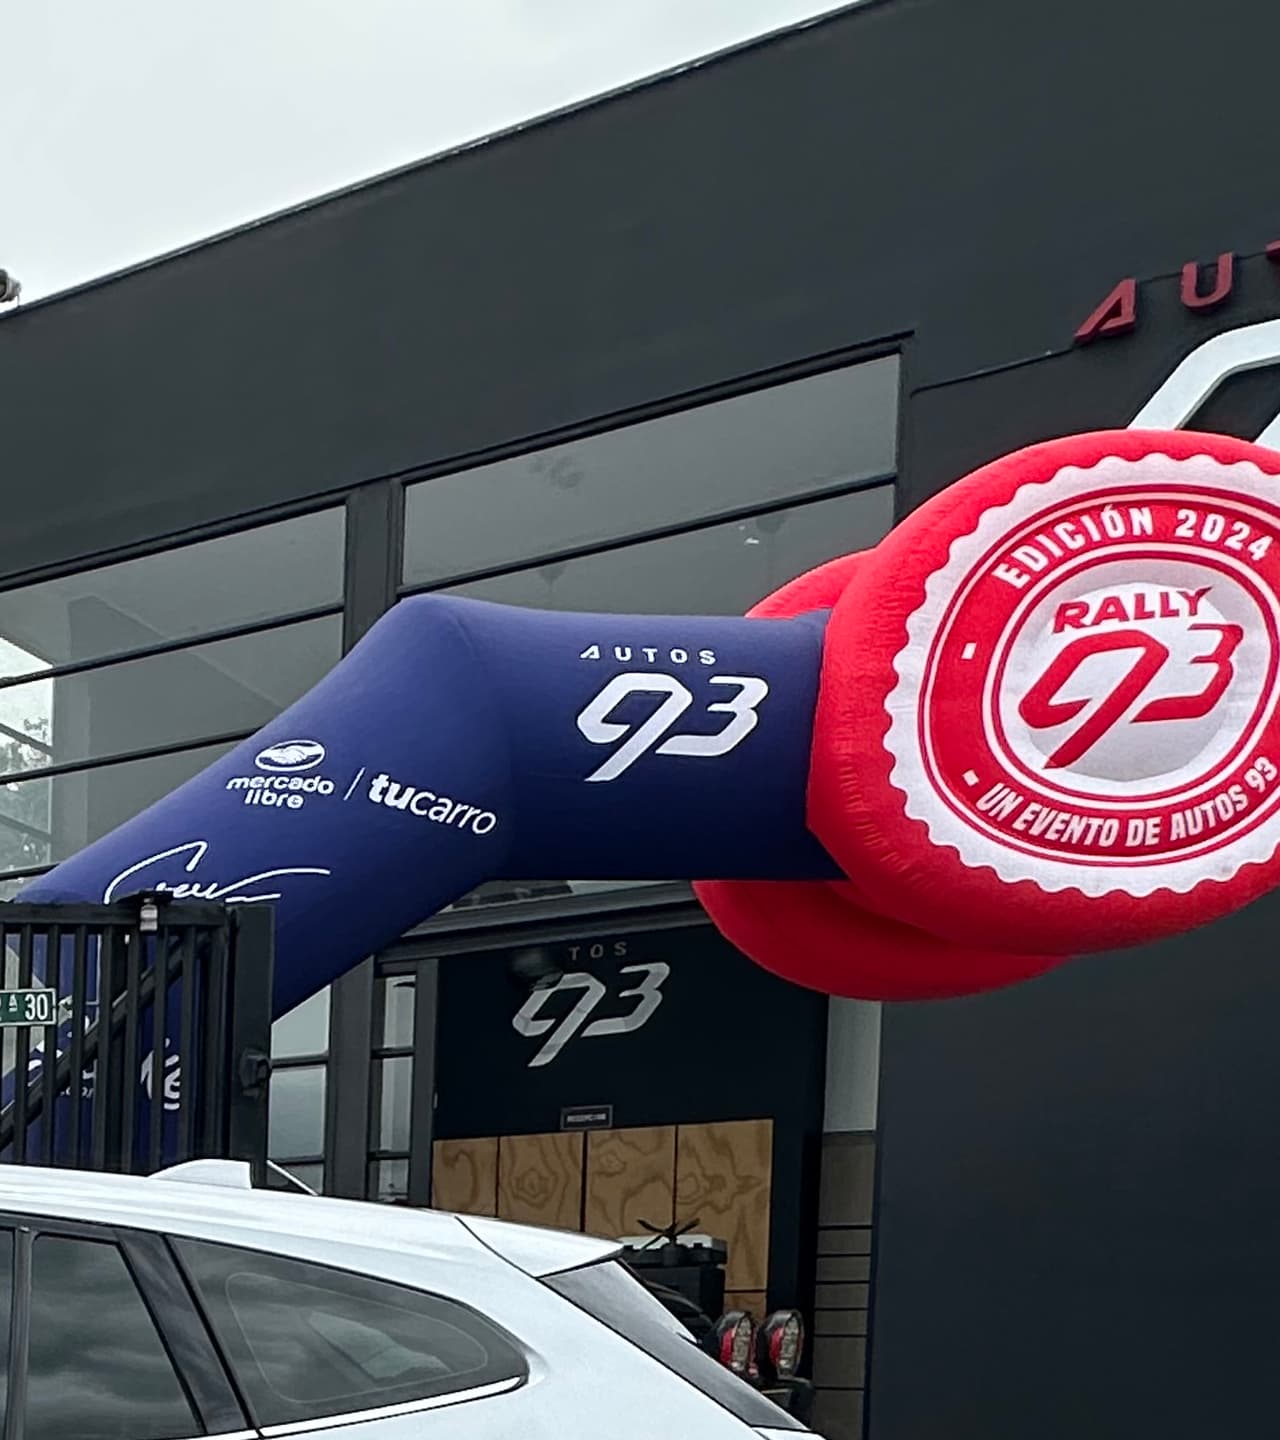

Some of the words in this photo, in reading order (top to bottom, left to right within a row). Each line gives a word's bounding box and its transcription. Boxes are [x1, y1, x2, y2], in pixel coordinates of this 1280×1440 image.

[1073, 238, 1280, 344] AU
[991, 503, 1154, 589] EDICIÓN
[1174, 508, 1274, 562] 2024
[1052, 586, 1214, 634] RALLY
[579, 644, 717, 666] AUTOS
[576, 671, 770, 783] 93
[1017, 623, 1244, 769] 93
[226, 773, 335, 795] mercado
[244, 788, 305, 810] libre
[368, 772, 497, 835] tucarro
[975, 782, 1020, 822] UN
[1012, 802, 1120, 848] EVENTO
[1124, 816, 1163, 848] DE
[1169, 784, 1249, 842] AUTOS
[1243, 756, 1278, 794] 93
[568, 941, 628, 962] TOS
[24, 993, 49, 1021] 30
[512, 961, 671, 1068] 93
